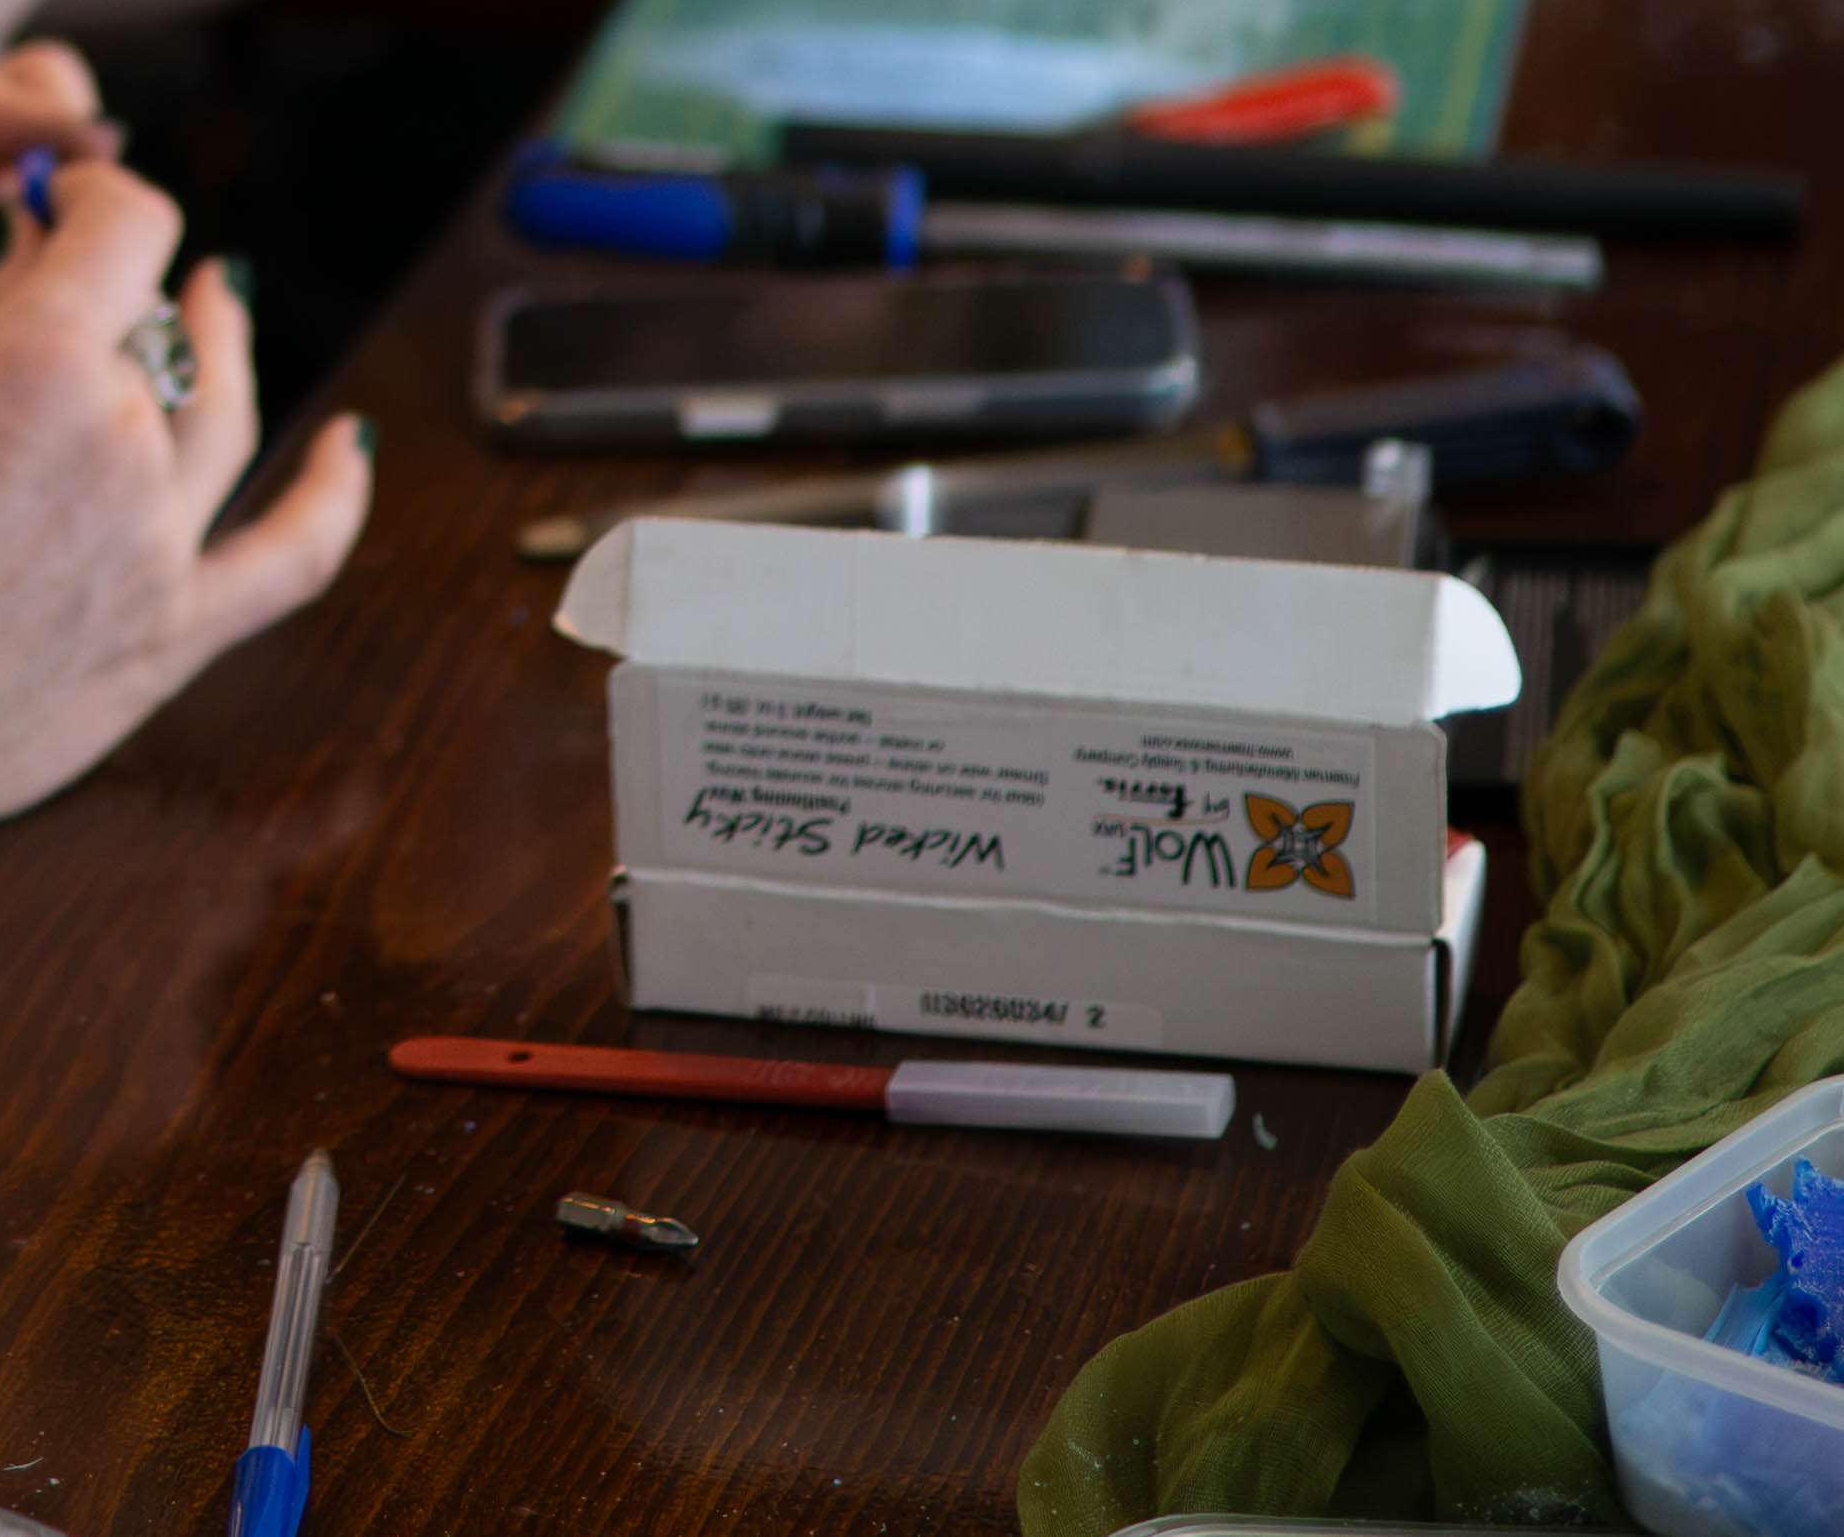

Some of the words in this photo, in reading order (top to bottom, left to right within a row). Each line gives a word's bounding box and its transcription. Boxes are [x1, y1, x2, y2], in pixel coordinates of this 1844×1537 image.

[683, 788, 834, 857] Sticky
[850, 821, 1006, 873] Wicked
[1086, 1004, 1106, 1028] 2
